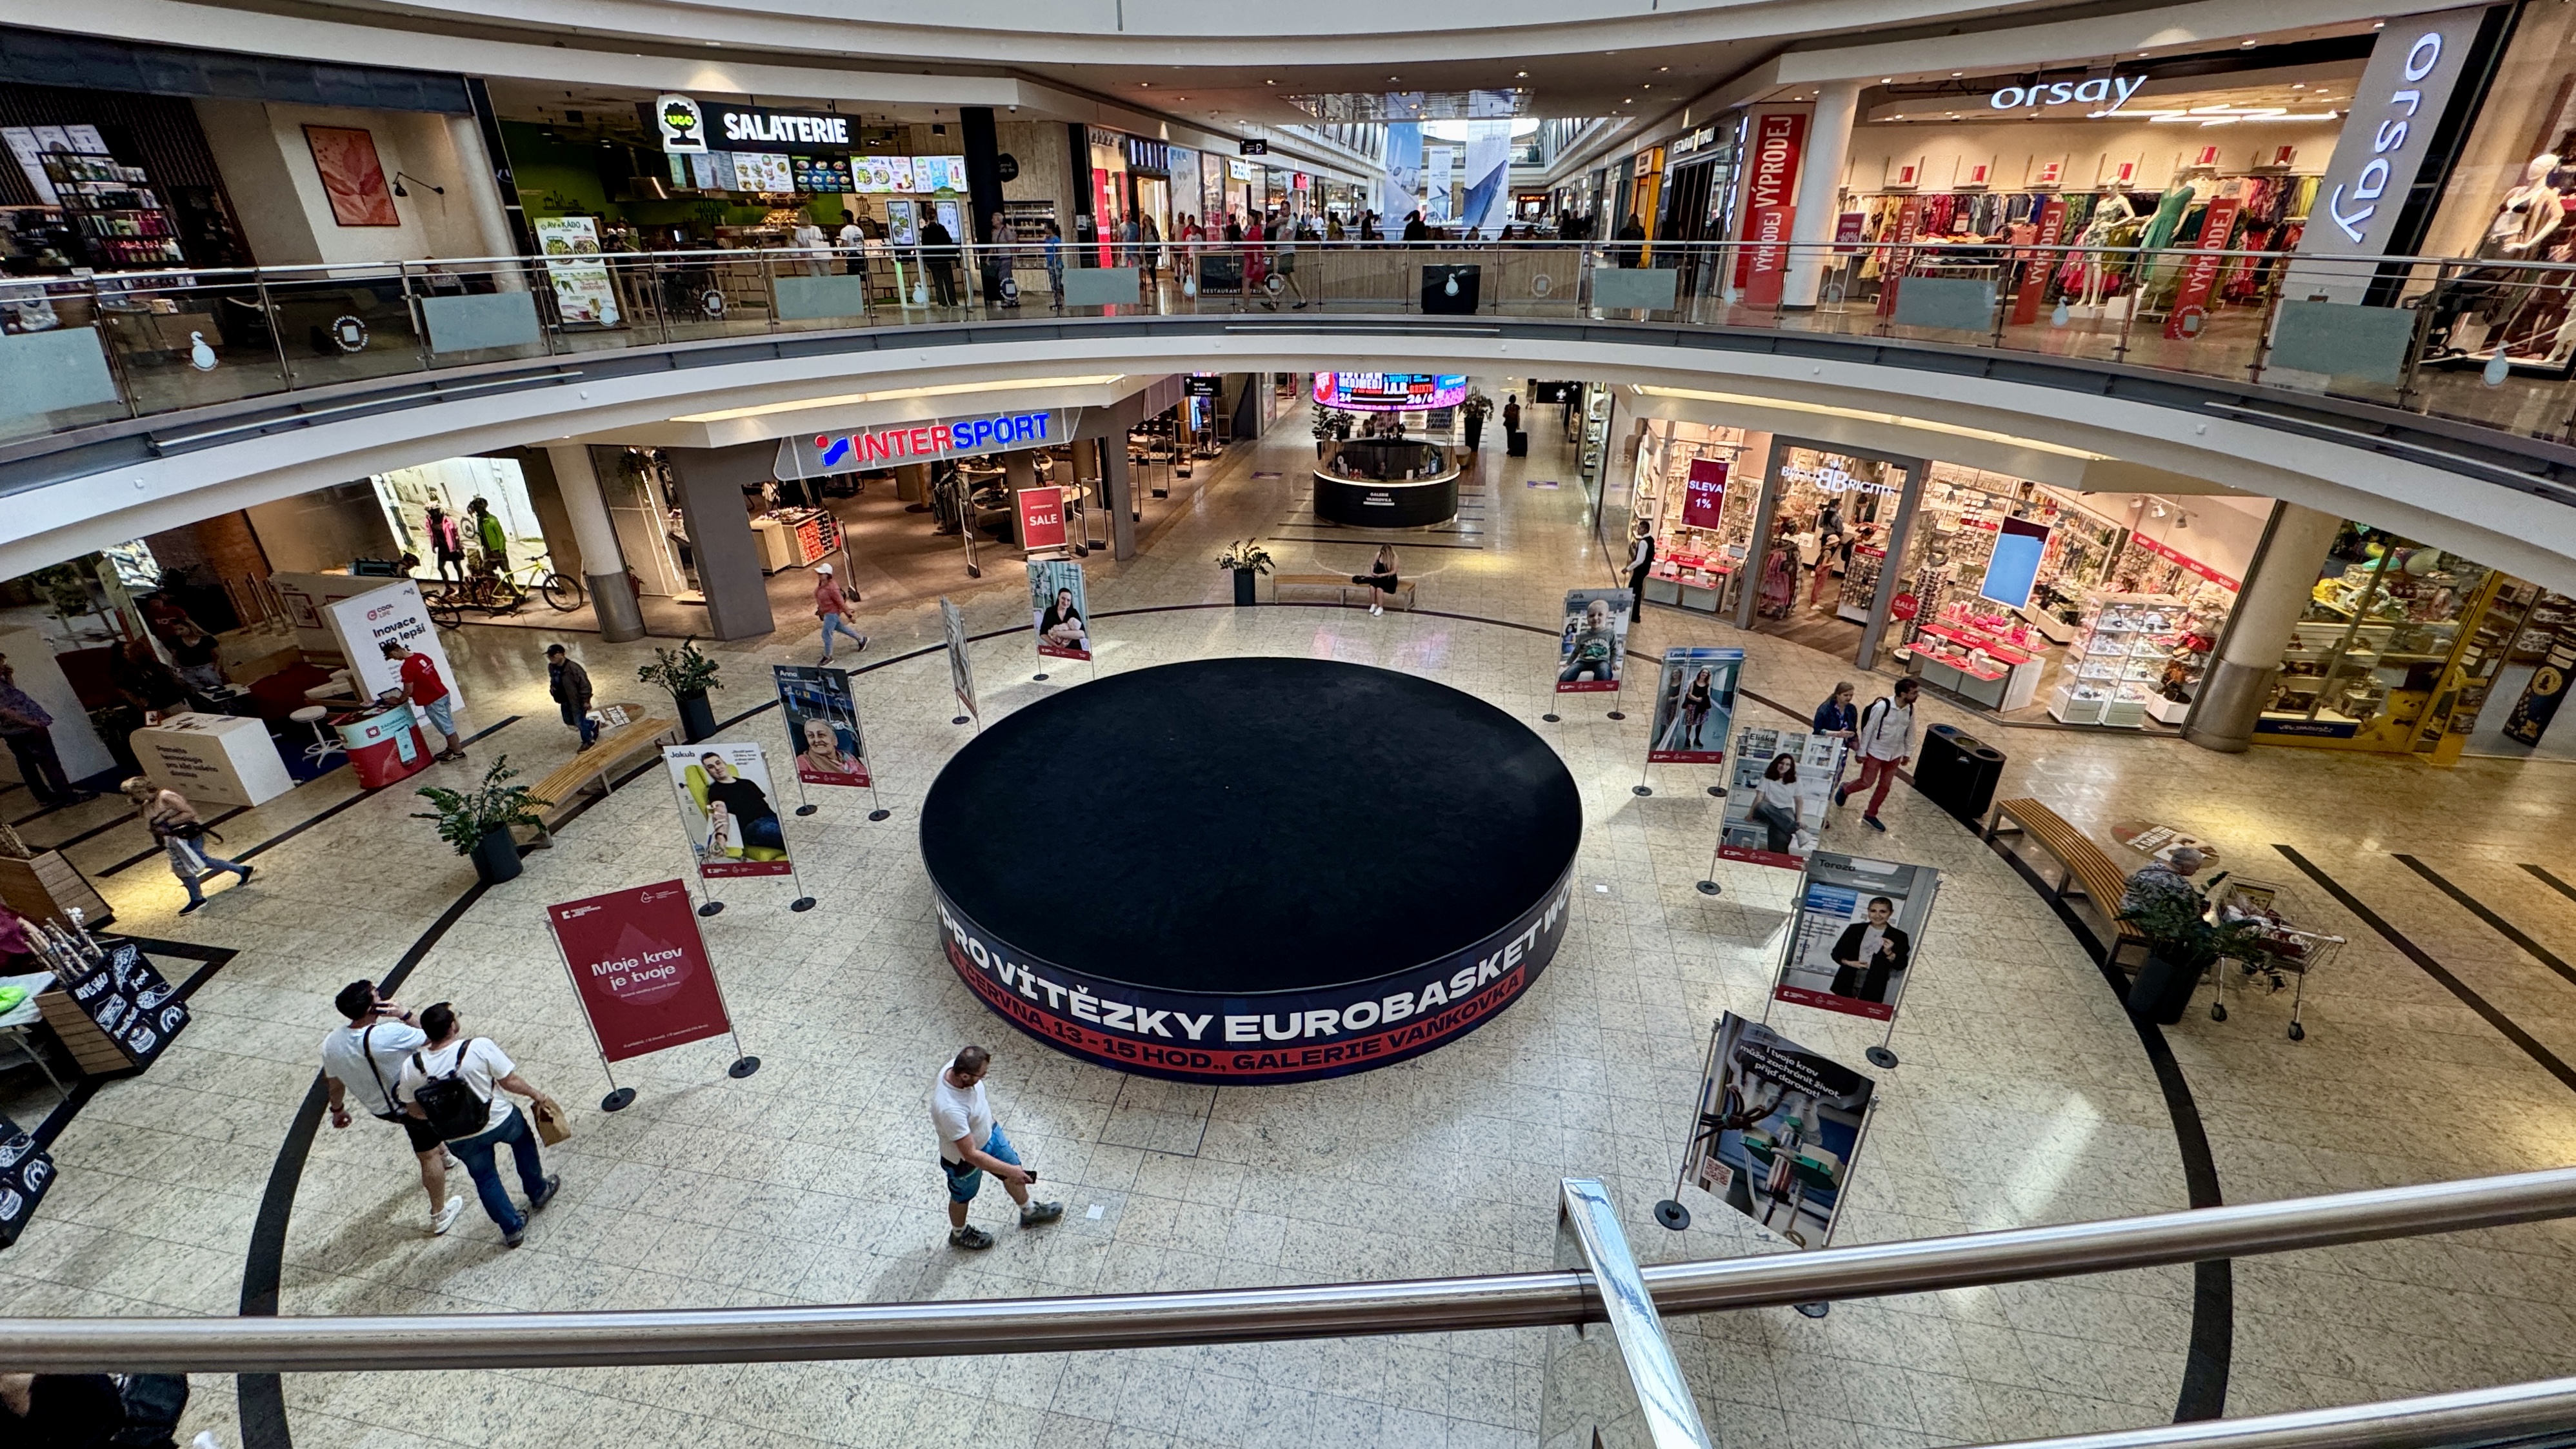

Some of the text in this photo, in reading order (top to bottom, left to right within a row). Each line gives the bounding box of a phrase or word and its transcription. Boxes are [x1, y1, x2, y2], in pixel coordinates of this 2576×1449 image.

[1991, 75, 2148, 118] orsay
[666, 114, 695, 126] UGO
[723, 112, 849, 143] SALATERIE
[2330, 32, 2442, 243] orsay
[1751, 116, 1793, 208] VÝPRODEJ
[1339, 392, 1434, 405] 24 26/6
[852, 412, 1050, 462] INTERSPORT
[1688, 480, 1723, 494] SLEVA
[1695, 497, 1712, 510] 1%
[1029, 514, 1058, 526] SALE
[1894, 600, 1916, 611] SALE
[372, 617, 416, 638] Inovace
[399, 623, 426, 641] lepší
[1961, 634, 1982, 644] SLEVY
[1750, 733, 1776, 742] Eliška
[1819, 859, 1856, 872] Tereza
[590, 946, 683, 977] Moje krev
[940, 901, 991, 970] PRO
[991, 952, 1214, 1041] VÍTĚZKY
[1224, 917, 1543, 1042] EUROBASKET
[75, 972, 109, 1000] MENU
[608, 964, 677, 992] je tvoje
[964, 963, 1051, 1034] ČERVNA,
[1053, 1021, 1083, 1044] 13
[1103, 1037, 1137, 1059] 15
[1142, 1046, 1226, 1072] HOD.,
[1233, 1037, 1382, 1071] GALERIE
[1740, 1044, 1766, 1061] může
[1766, 1057, 1814, 1085] zachránit
[1771, 1050, 1795, 1065] tvoje
[1796, 1060, 1819, 1077] krev
[1754, 1062, 1821, 1099] přijď darovat!
